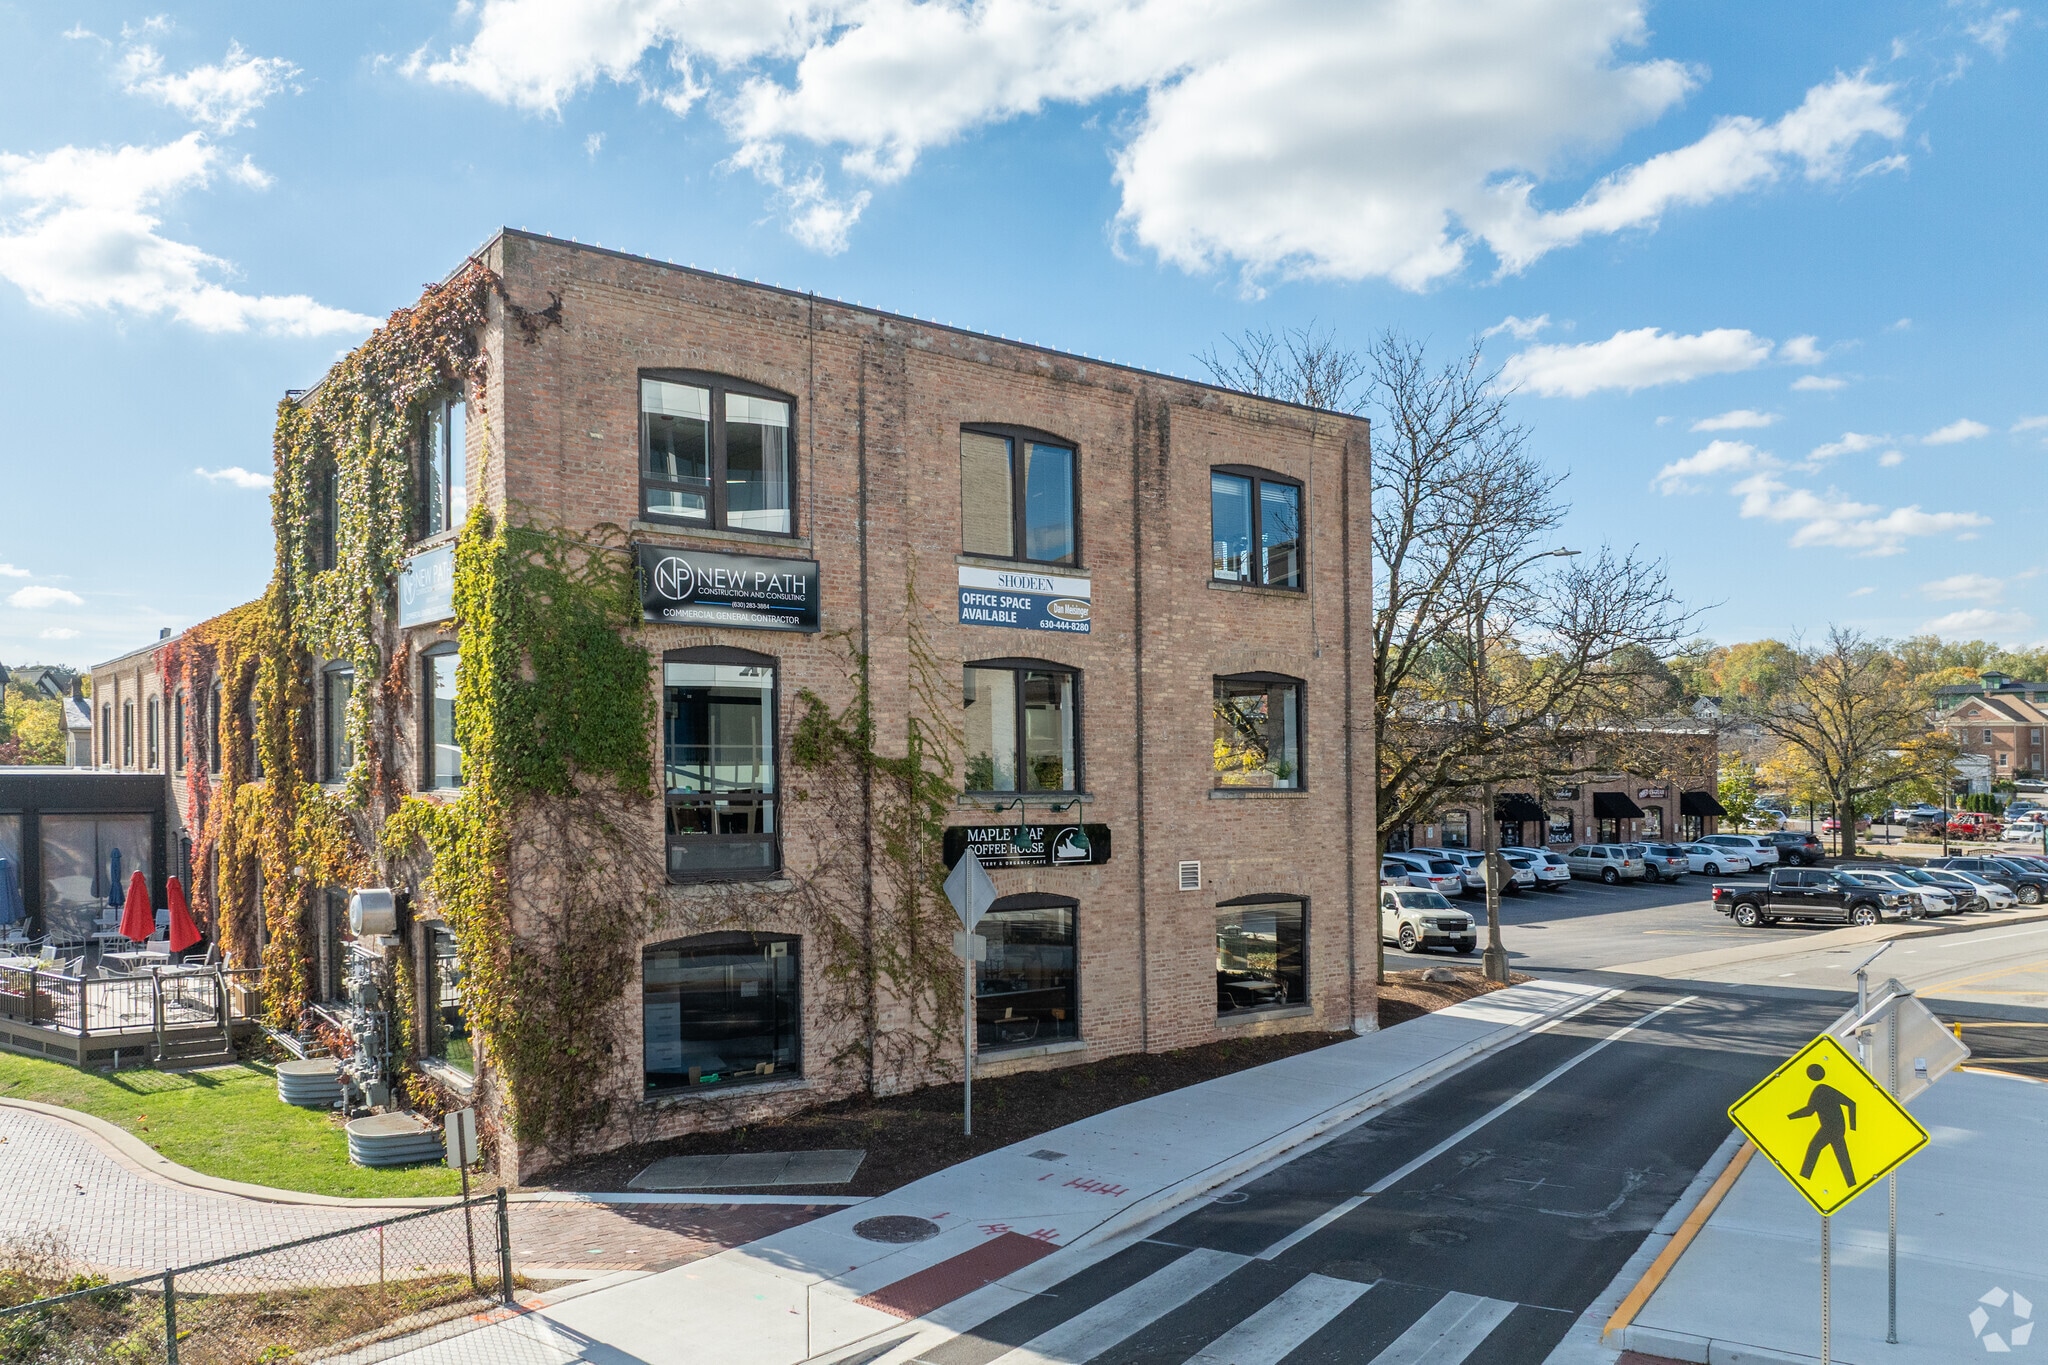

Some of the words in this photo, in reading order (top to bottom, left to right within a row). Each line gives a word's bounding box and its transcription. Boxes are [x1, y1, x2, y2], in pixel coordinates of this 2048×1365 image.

[697, 566, 747, 590] NEW
[755, 571, 806, 594] PATH
[998, 574, 1054, 591] SHODEEN
[698, 587, 749, 598] CONSTRUCTION
[750, 591, 765, 599] AND
[766, 592, 806, 601] CONSULTING
[962, 592, 997, 607] OFFICE
[1000, 596, 1031, 610] SPACE
[663, 608, 714, 619] COMMERCIAL
[716, 611, 749, 621] GENERAL
[751, 614, 800, 624] CONTRACTOR
[962, 608, 1017, 623] AVAILABLE
[1040, 620, 1089, 632] 630-444-8280
[967, 828, 1010, 842] MAPLE
[1014, 827, 1044, 840] LAF
